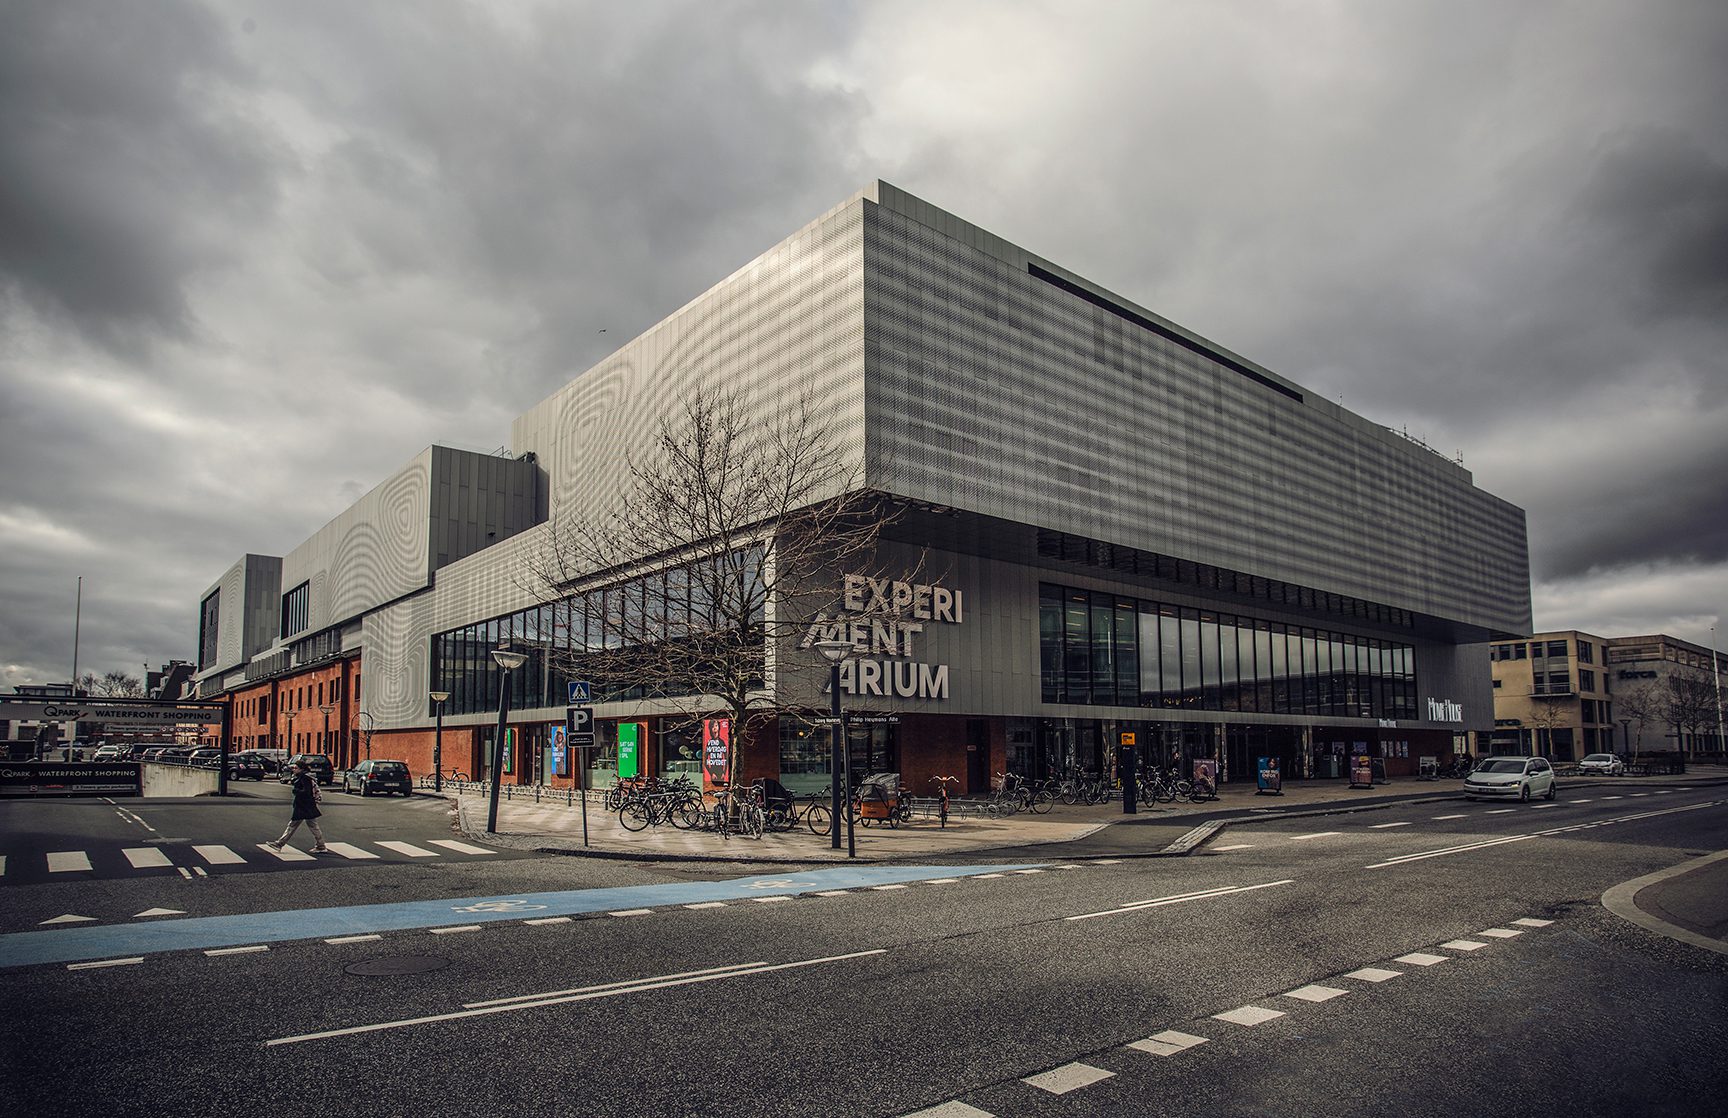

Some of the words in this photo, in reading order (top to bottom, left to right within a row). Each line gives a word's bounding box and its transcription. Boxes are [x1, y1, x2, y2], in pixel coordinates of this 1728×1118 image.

[845, 573, 963, 624] EXPERI
[801, 612, 923, 657] MENT
[825, 658, 949, 699] ARIUM
[95, 710, 161, 719] WATERFRONT
[163, 712, 212, 720] SHOPPING
[573, 711, 588, 731] P
